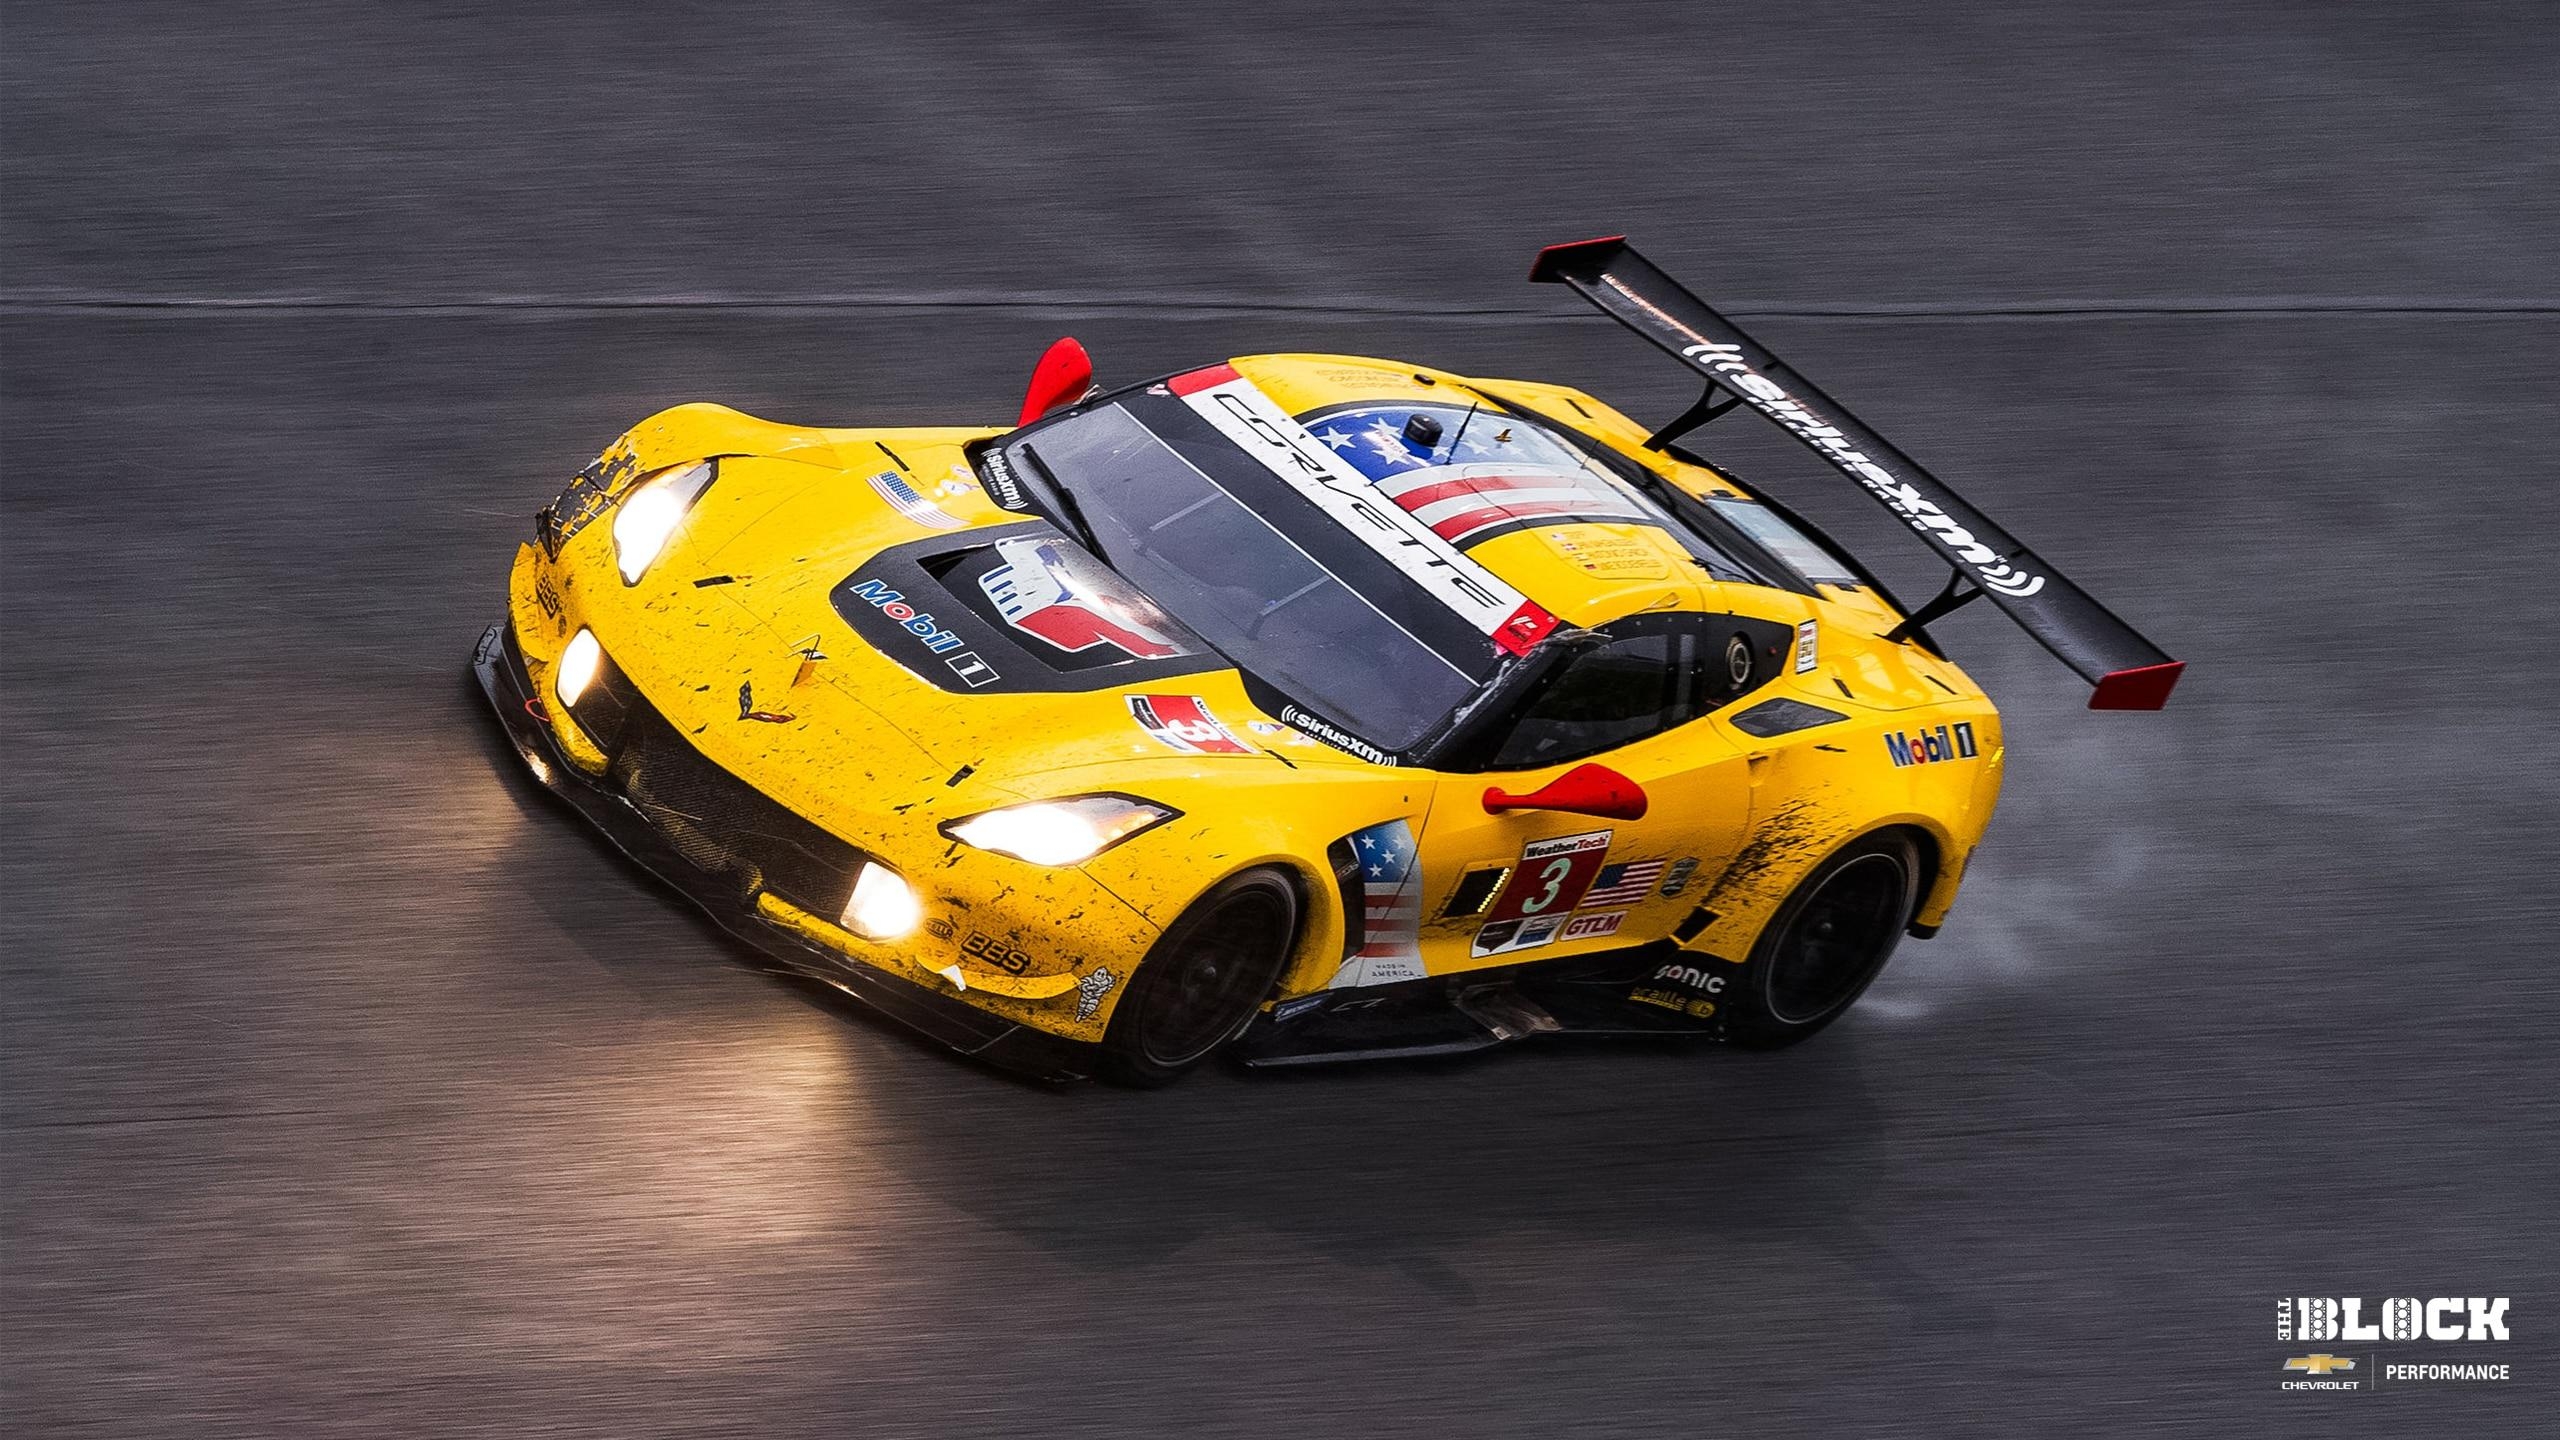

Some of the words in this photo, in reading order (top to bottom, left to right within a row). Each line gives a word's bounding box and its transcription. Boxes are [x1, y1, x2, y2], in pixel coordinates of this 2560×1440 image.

[1213, 394, 1505, 608] CORVETTE
[849, 579, 965, 654] Mobil
[1883, 725, 1955, 768] Mobil
[1957, 724, 1976, 757] 1
[1526, 836, 1608, 857] WeatherTech
[1522, 858, 1571, 914] 3
[1566, 915, 1622, 936] GTLM
[961, 930, 1031, 975] BBS
[1371, 970, 1415, 978] AMERICA
